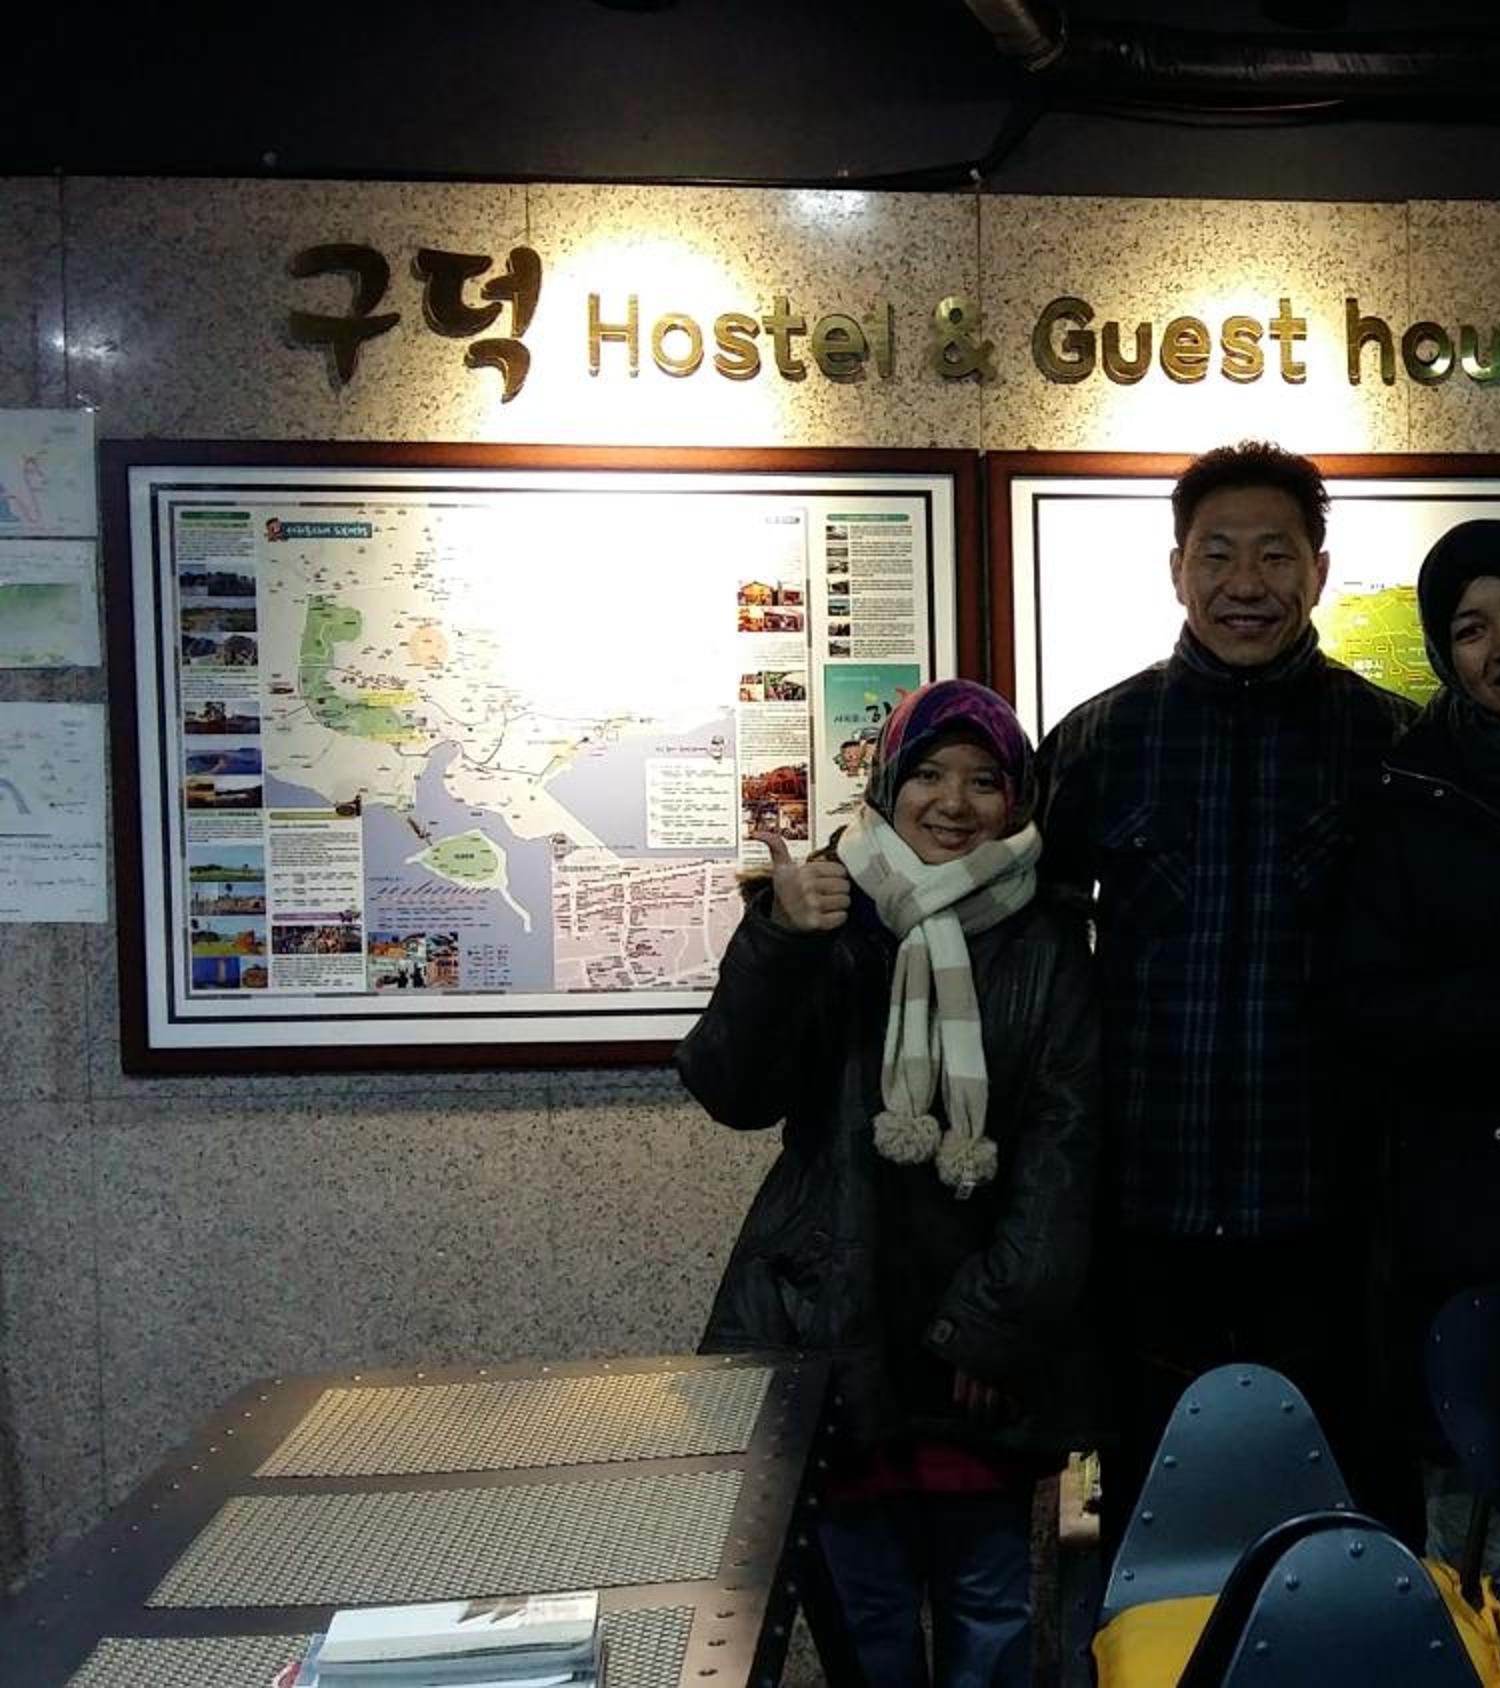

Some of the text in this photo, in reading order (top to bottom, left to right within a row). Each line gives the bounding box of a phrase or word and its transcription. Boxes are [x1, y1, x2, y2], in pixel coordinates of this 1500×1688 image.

[288, 243, 544, 405] 구덕
[588, 292, 896, 383] Hostel
[932, 296, 993, 381] &
[1031, 296, 1308, 385] Guest
